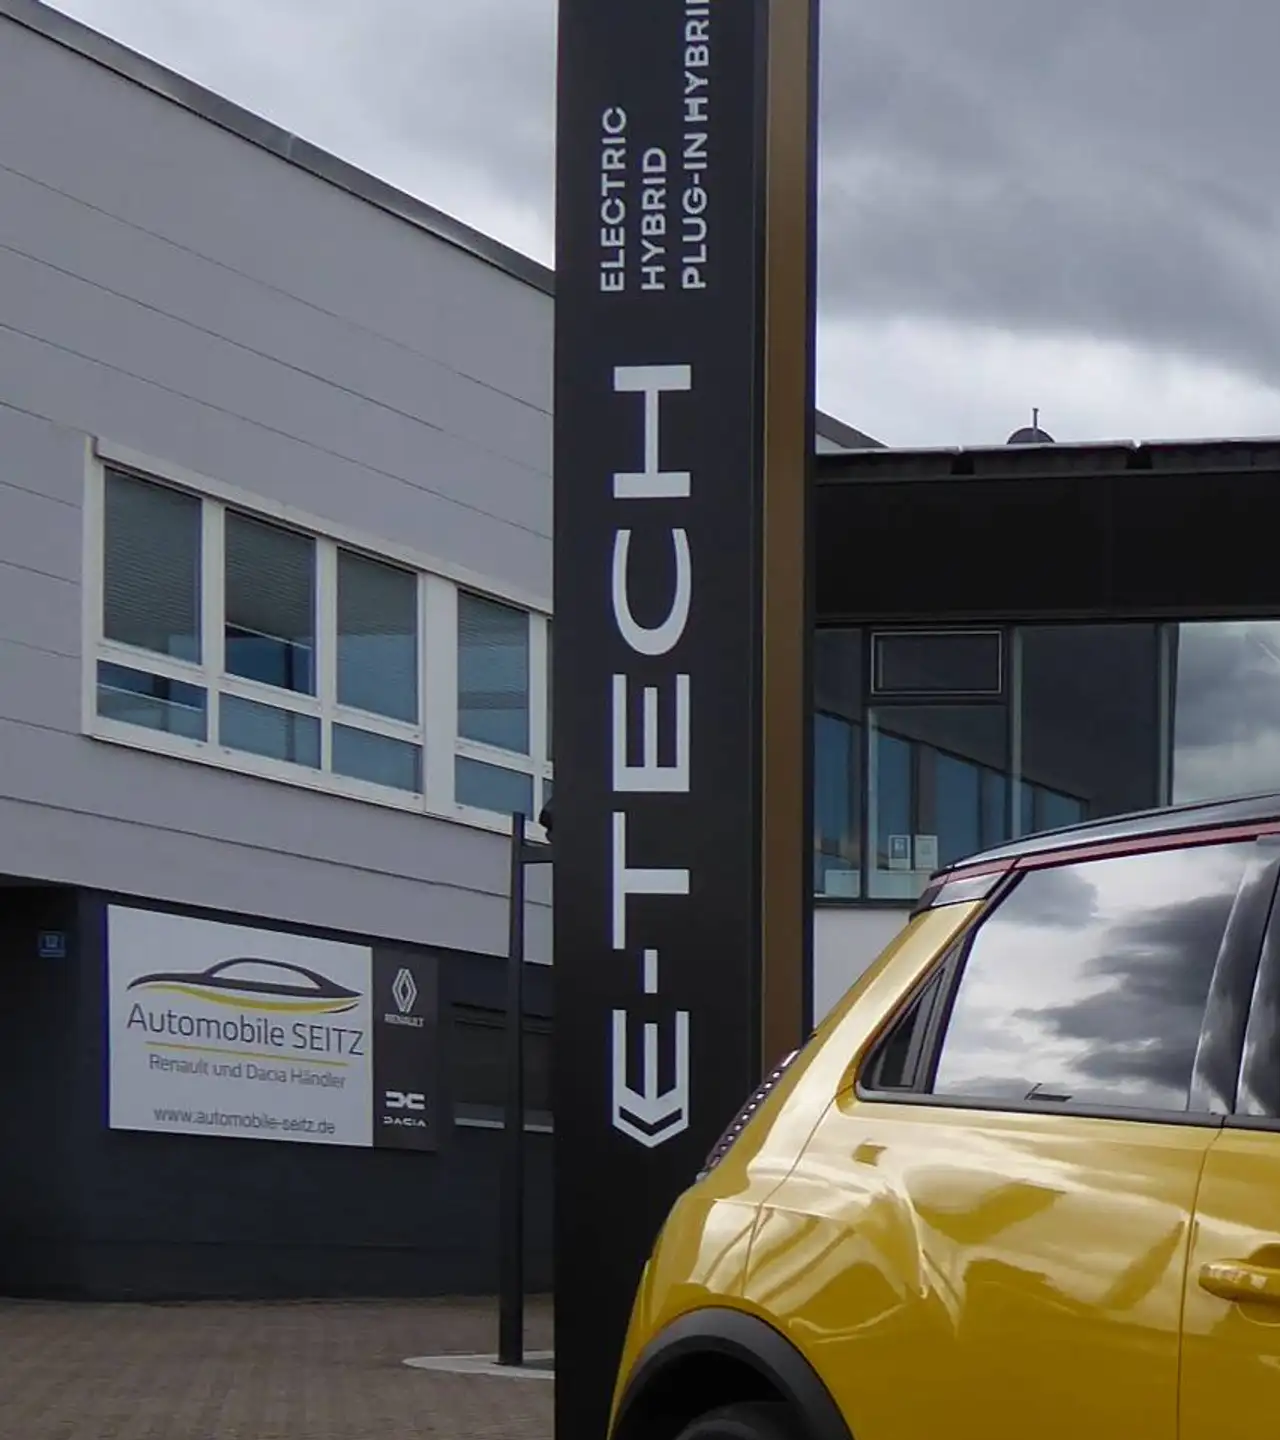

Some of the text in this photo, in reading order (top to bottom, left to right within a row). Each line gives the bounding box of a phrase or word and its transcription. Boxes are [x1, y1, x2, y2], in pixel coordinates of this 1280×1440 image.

[682, 0, 710, 289] PLUG-IN HYBRI
[600, 106, 627, 292] ELECTRIC
[641, 147, 667, 290] HYBRID
[612, 364, 692, 1148] E-TECH
[126, 1002, 365, 1057] Automobile SEITZ
[149, 1053, 346, 1090] Renault und Dacia Händler
[153, 1105, 337, 1136] www.automobile-seitz.de
[383, 1115, 428, 1128] DACIA
